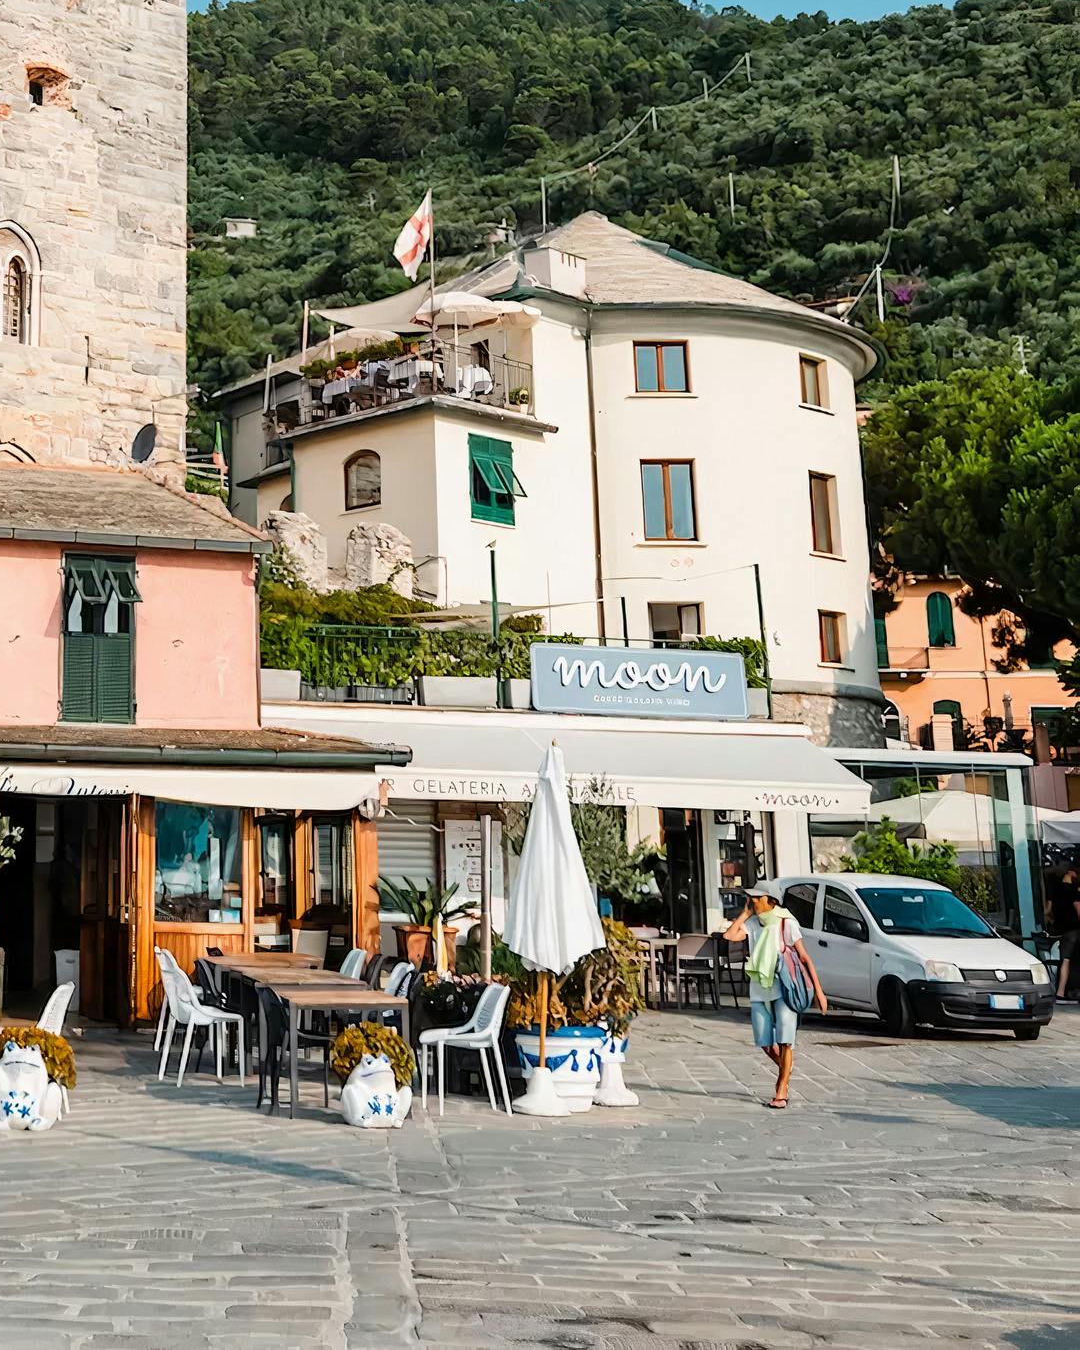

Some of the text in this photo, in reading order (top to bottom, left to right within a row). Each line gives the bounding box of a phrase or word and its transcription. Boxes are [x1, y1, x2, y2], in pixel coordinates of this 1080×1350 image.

[553, 656, 726, 693] moon
[413, 779, 507, 795] GELATERIA
[762, 793, 831, 807] moon
